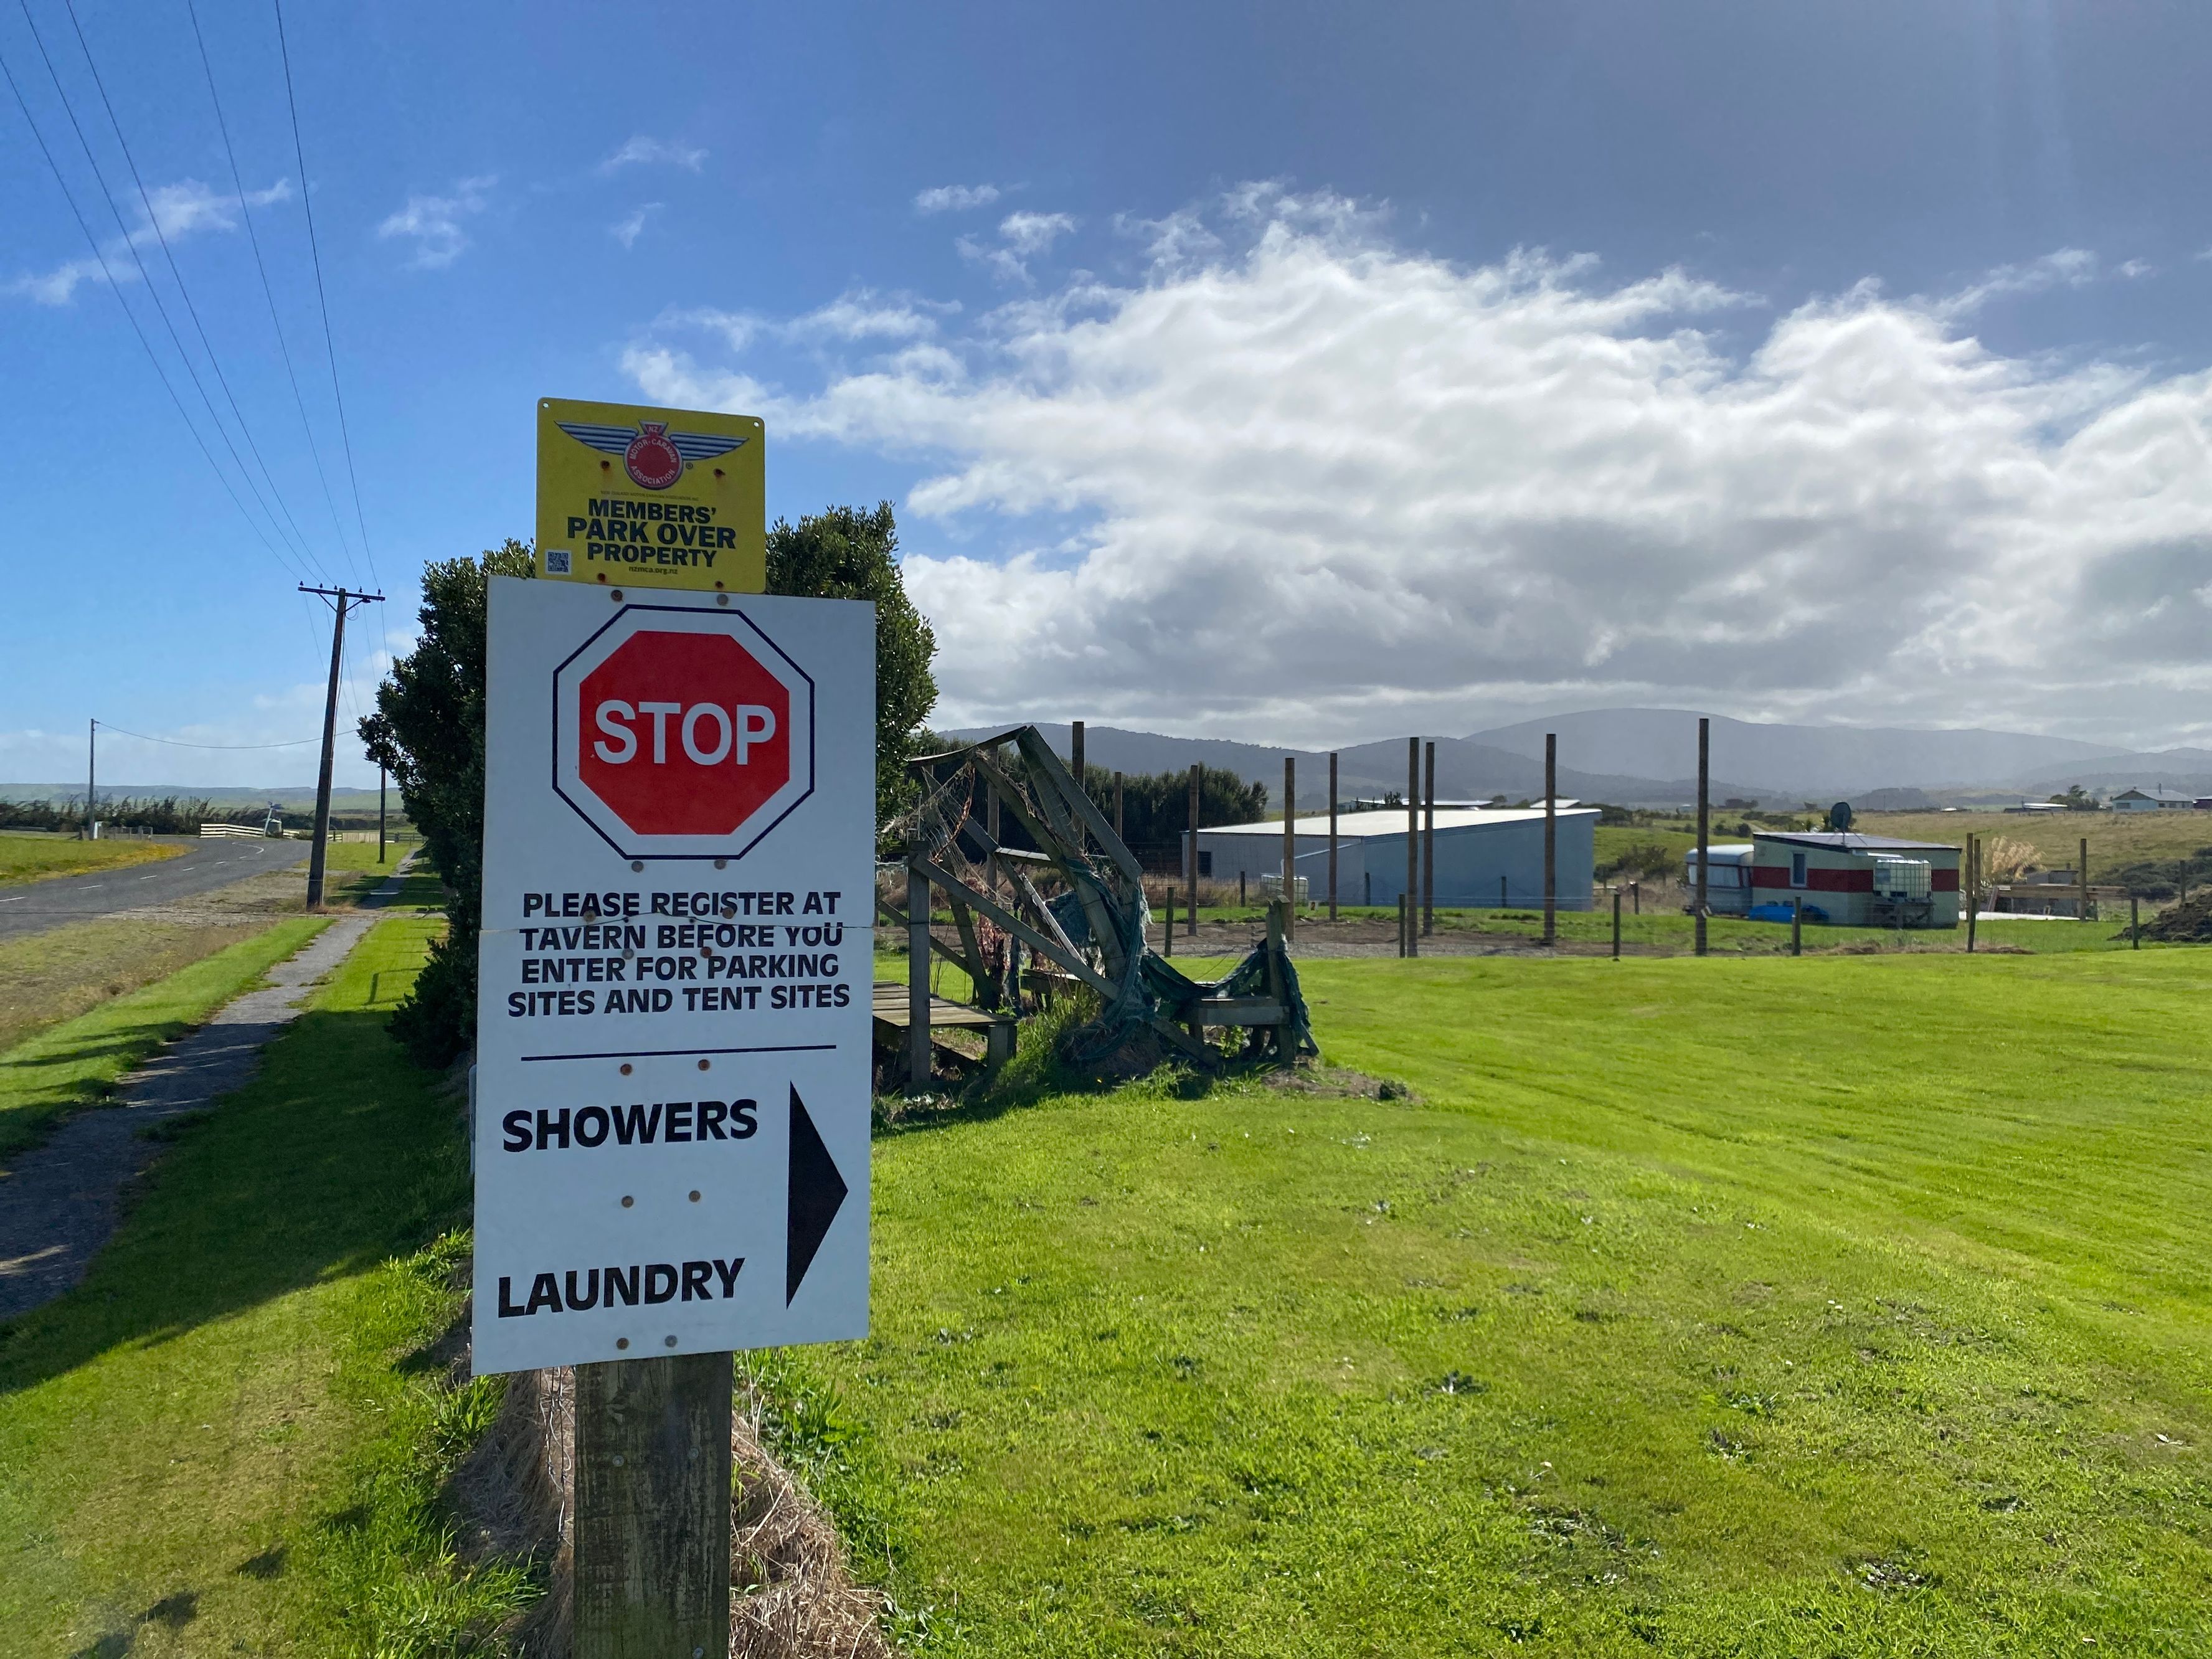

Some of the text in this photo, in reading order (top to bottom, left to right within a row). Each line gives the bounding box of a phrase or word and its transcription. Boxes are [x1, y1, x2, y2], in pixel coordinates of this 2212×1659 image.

[630, 438, 677, 463] MOTOR CARAVAN
[631, 466, 676, 484] ASSOCIATION
[567, 516, 736, 549] PARK OVER
[587, 542, 717, 567] PROPERTY
[628, 566, 678, 575] nzmca.org.nz
[593, 699, 776, 766] STOP
[524, 892, 841, 917] PLEASE REGISTER AT
[519, 922, 843, 951] TAVERN BEFORE YOU
[522, 953, 839, 984] ENTER FOR PARKING
[508, 984, 850, 1017] SITES AND TENT SITES
[502, 1099, 757, 1152] SHOWERS
[498, 1257, 745, 1318] LAUNDRY
